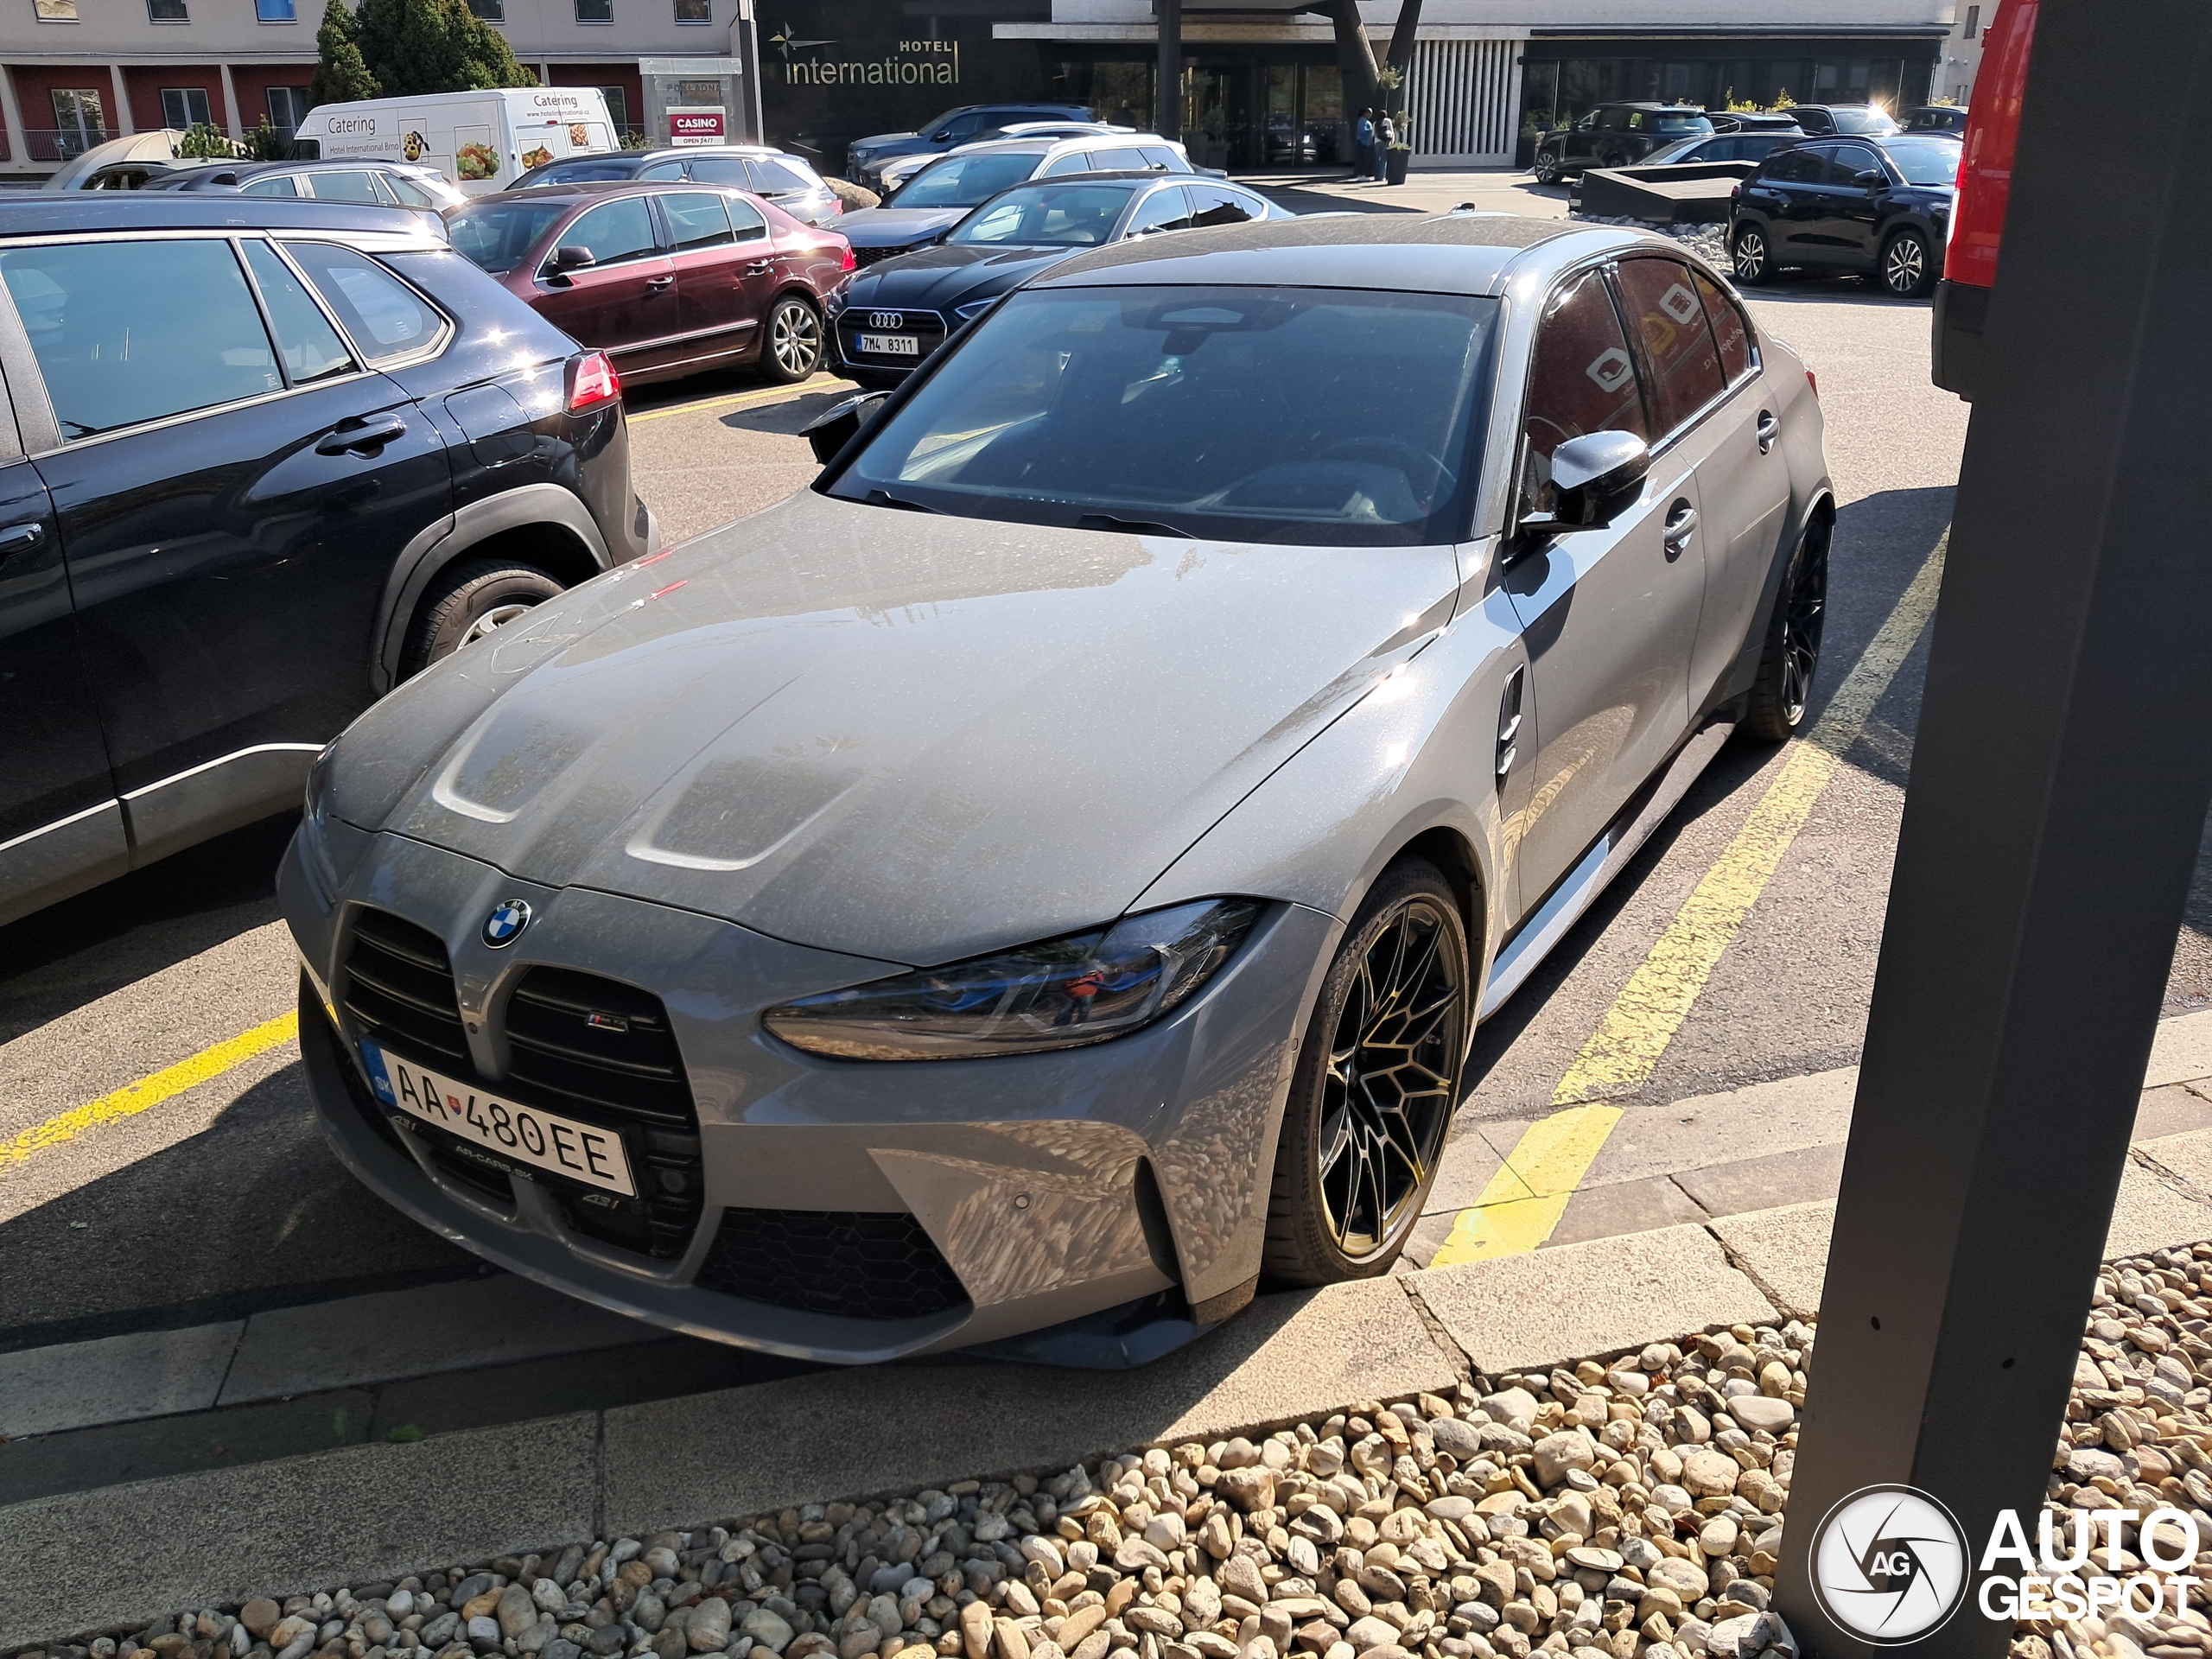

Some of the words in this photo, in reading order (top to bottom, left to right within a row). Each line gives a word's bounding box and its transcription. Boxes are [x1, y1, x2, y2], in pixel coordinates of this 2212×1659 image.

[899, 41, 952, 52] HOTEL
[785, 41, 959, 85] international
[533, 94, 578, 109] Catering
[327, 116, 376, 136] Catering
[677, 118, 718, 128] CASINO
[329, 144, 346, 156] Hotel
[346, 143, 384, 154] International
[385, 142, 399, 151] Brno
[863, 337, 881, 350] 7M4
[887, 338, 912, 353] 8311
[375, 1076, 393, 1096] SK
[397, 1064, 449, 1122] AA
[467, 1095, 615, 1180] 480EE
[455, 1145, 534, 1182] AR-CARS.SK
